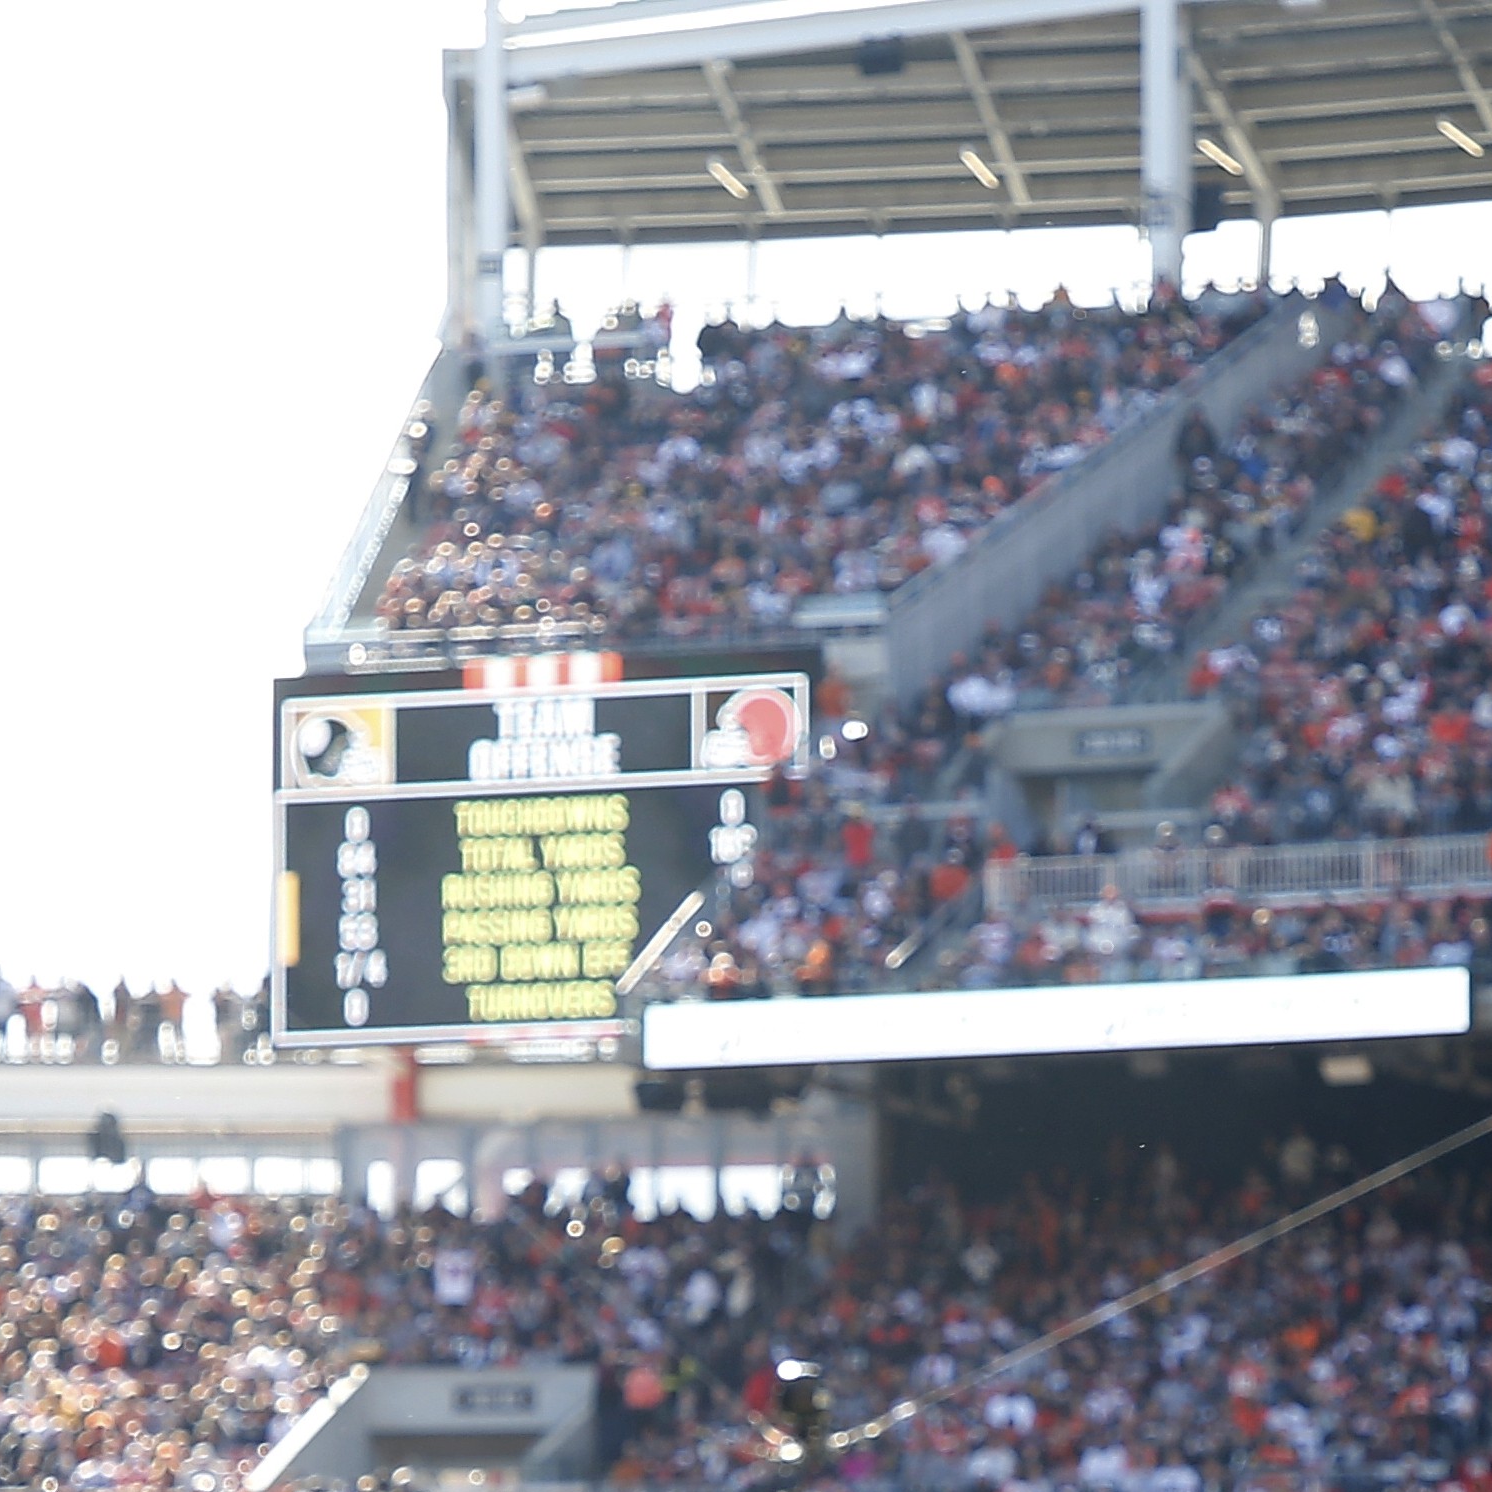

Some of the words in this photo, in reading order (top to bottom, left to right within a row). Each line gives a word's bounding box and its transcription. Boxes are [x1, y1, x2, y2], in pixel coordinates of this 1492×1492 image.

[454, 794, 631, 837] TOUCHDOWNS
[460, 837, 538, 872] TOTAL
[540, 831, 626, 868] YARDS
[442, 872, 555, 909] RUSHING
[554, 865, 641, 904] YARDS
[443, 907, 553, 946] PASSING
[552, 902, 639, 941] YARDS
[442, 945, 498, 985] 3RD
[500, 942, 579, 981] DOWN
[466, 979, 617, 1022] TURNOVERS
